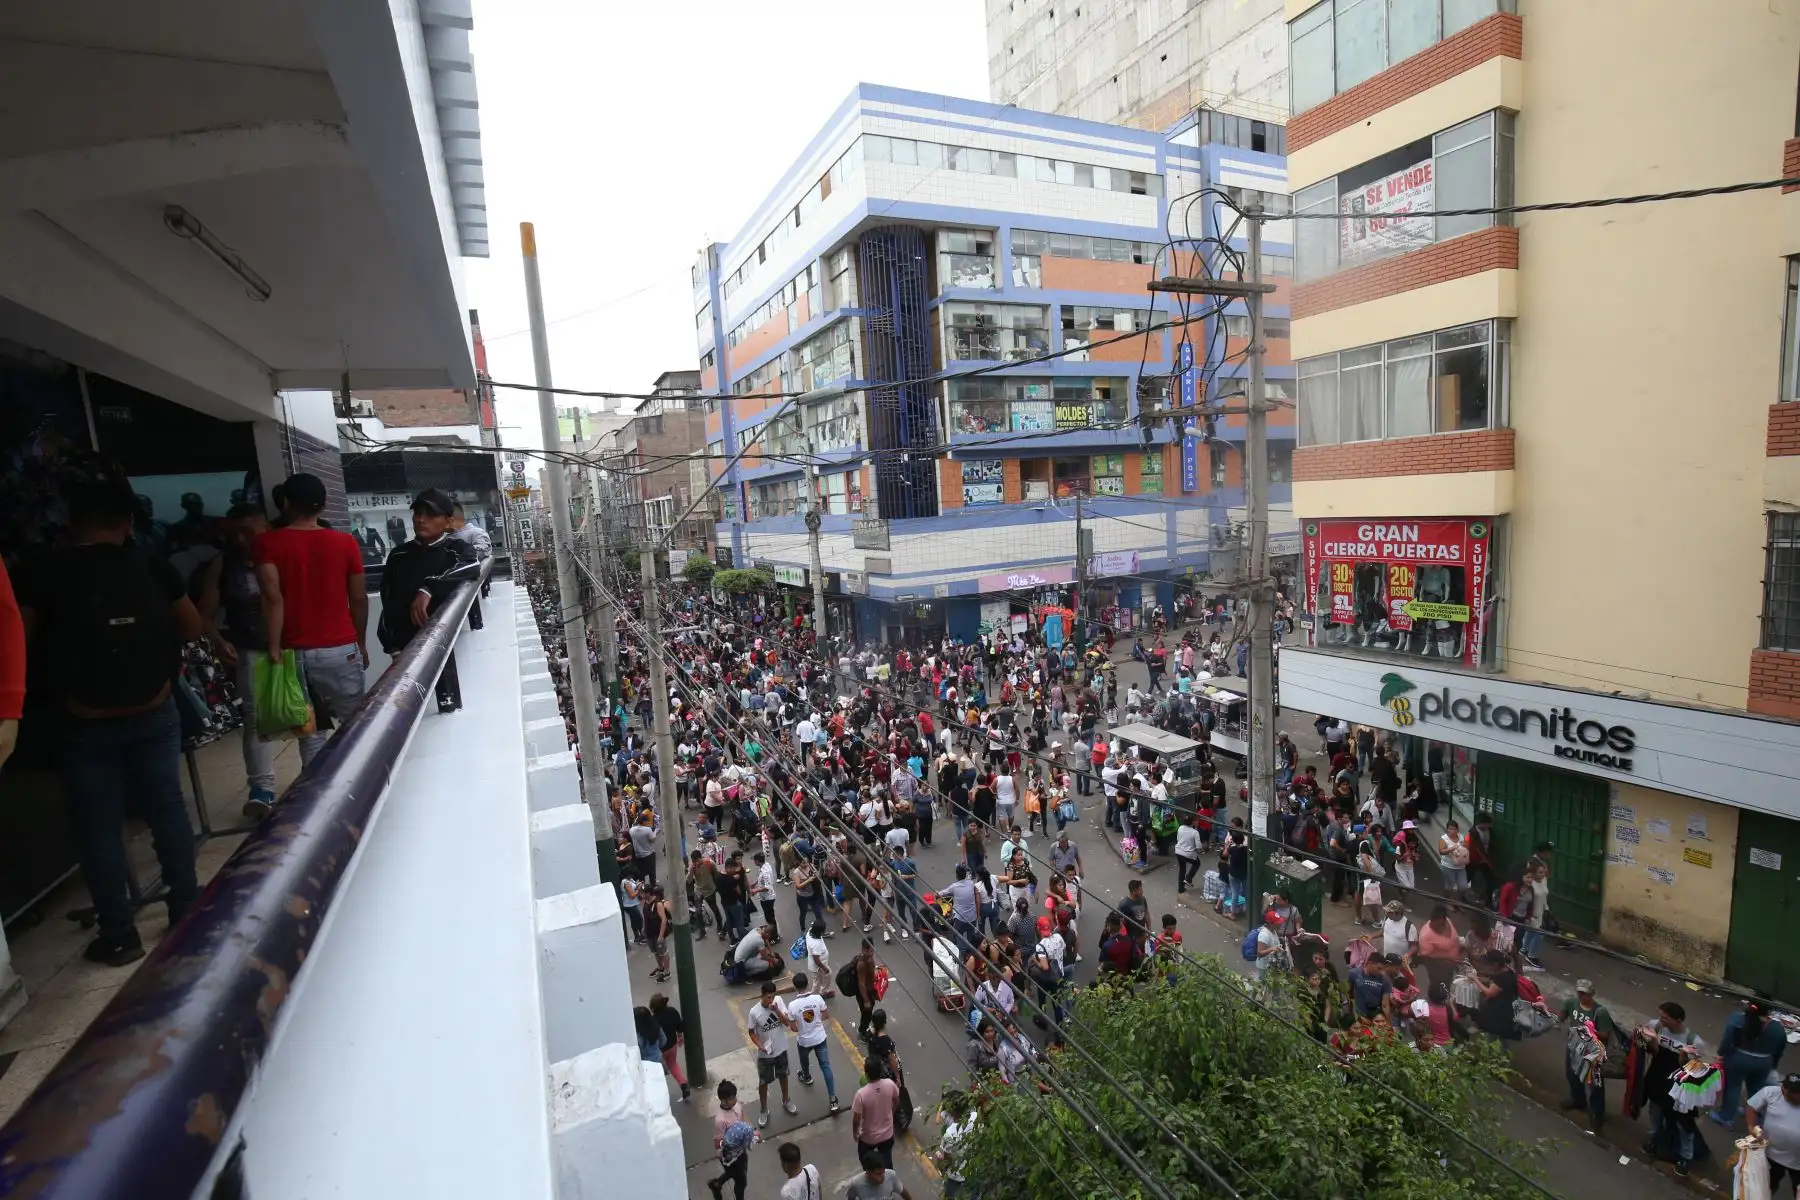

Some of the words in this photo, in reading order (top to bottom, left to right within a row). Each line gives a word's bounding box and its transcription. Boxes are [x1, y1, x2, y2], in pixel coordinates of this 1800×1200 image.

[1366, 184, 1383, 206] SE
[1387, 163, 1433, 198] VENDE
[1055, 406, 1087, 420] MOLDES
[520, 520, 534, 549] REY
[1358, 524, 1419, 542] GRAN
[1324, 542, 1378, 557] CIERRA
[1383, 544, 1460, 560] PUERTAS
[1309, 540, 1317, 603] SUPPLEX
[1472, 543, 1482, 618] SUPPLEX
[1390, 586, 1413, 598] DSCTO
[1418, 686, 1636, 753] platanitos
[1554, 744, 1634, 771] BOUTIQUE
